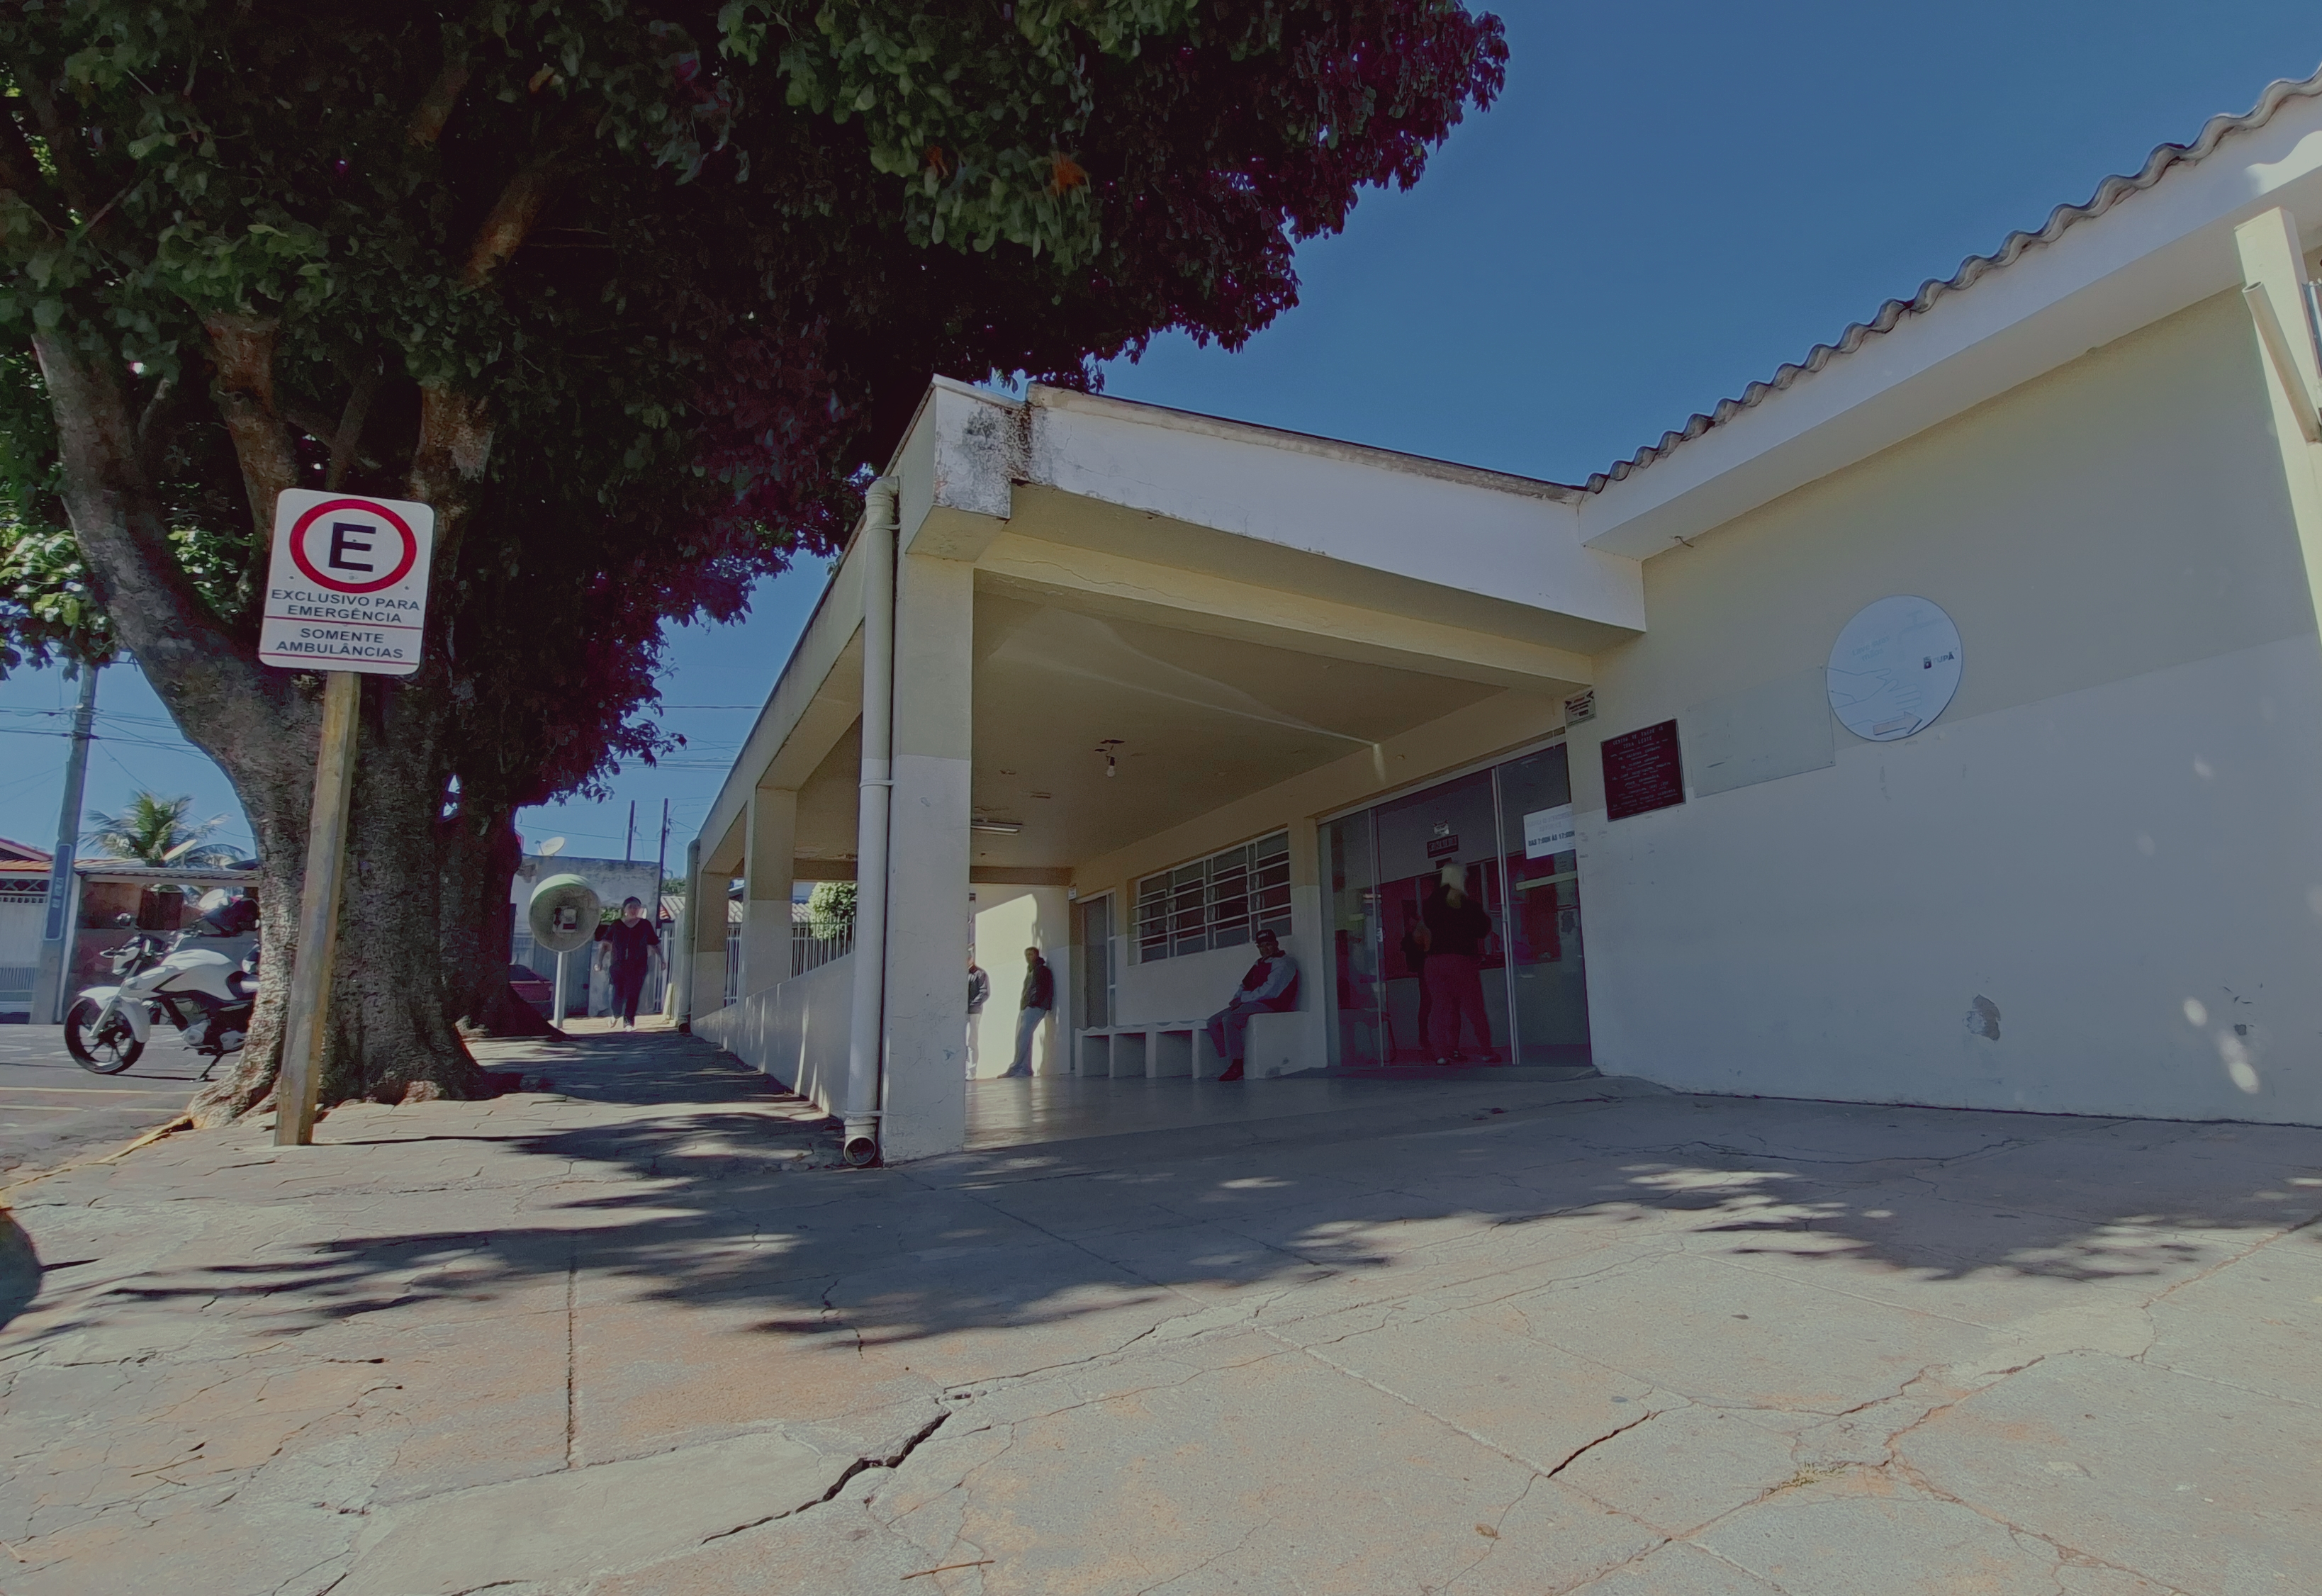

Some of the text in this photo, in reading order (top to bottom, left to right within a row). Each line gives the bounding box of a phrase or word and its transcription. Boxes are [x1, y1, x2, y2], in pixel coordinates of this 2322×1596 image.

[328, 522, 376, 573] E
[271, 589, 420, 611] EXCLUSIVO PARA
[287, 605, 402, 623] EMERGÊNCIA
[300, 628, 384, 644] SOMENTE
[276, 641, 403, 659] AMBULÂNCIAS
